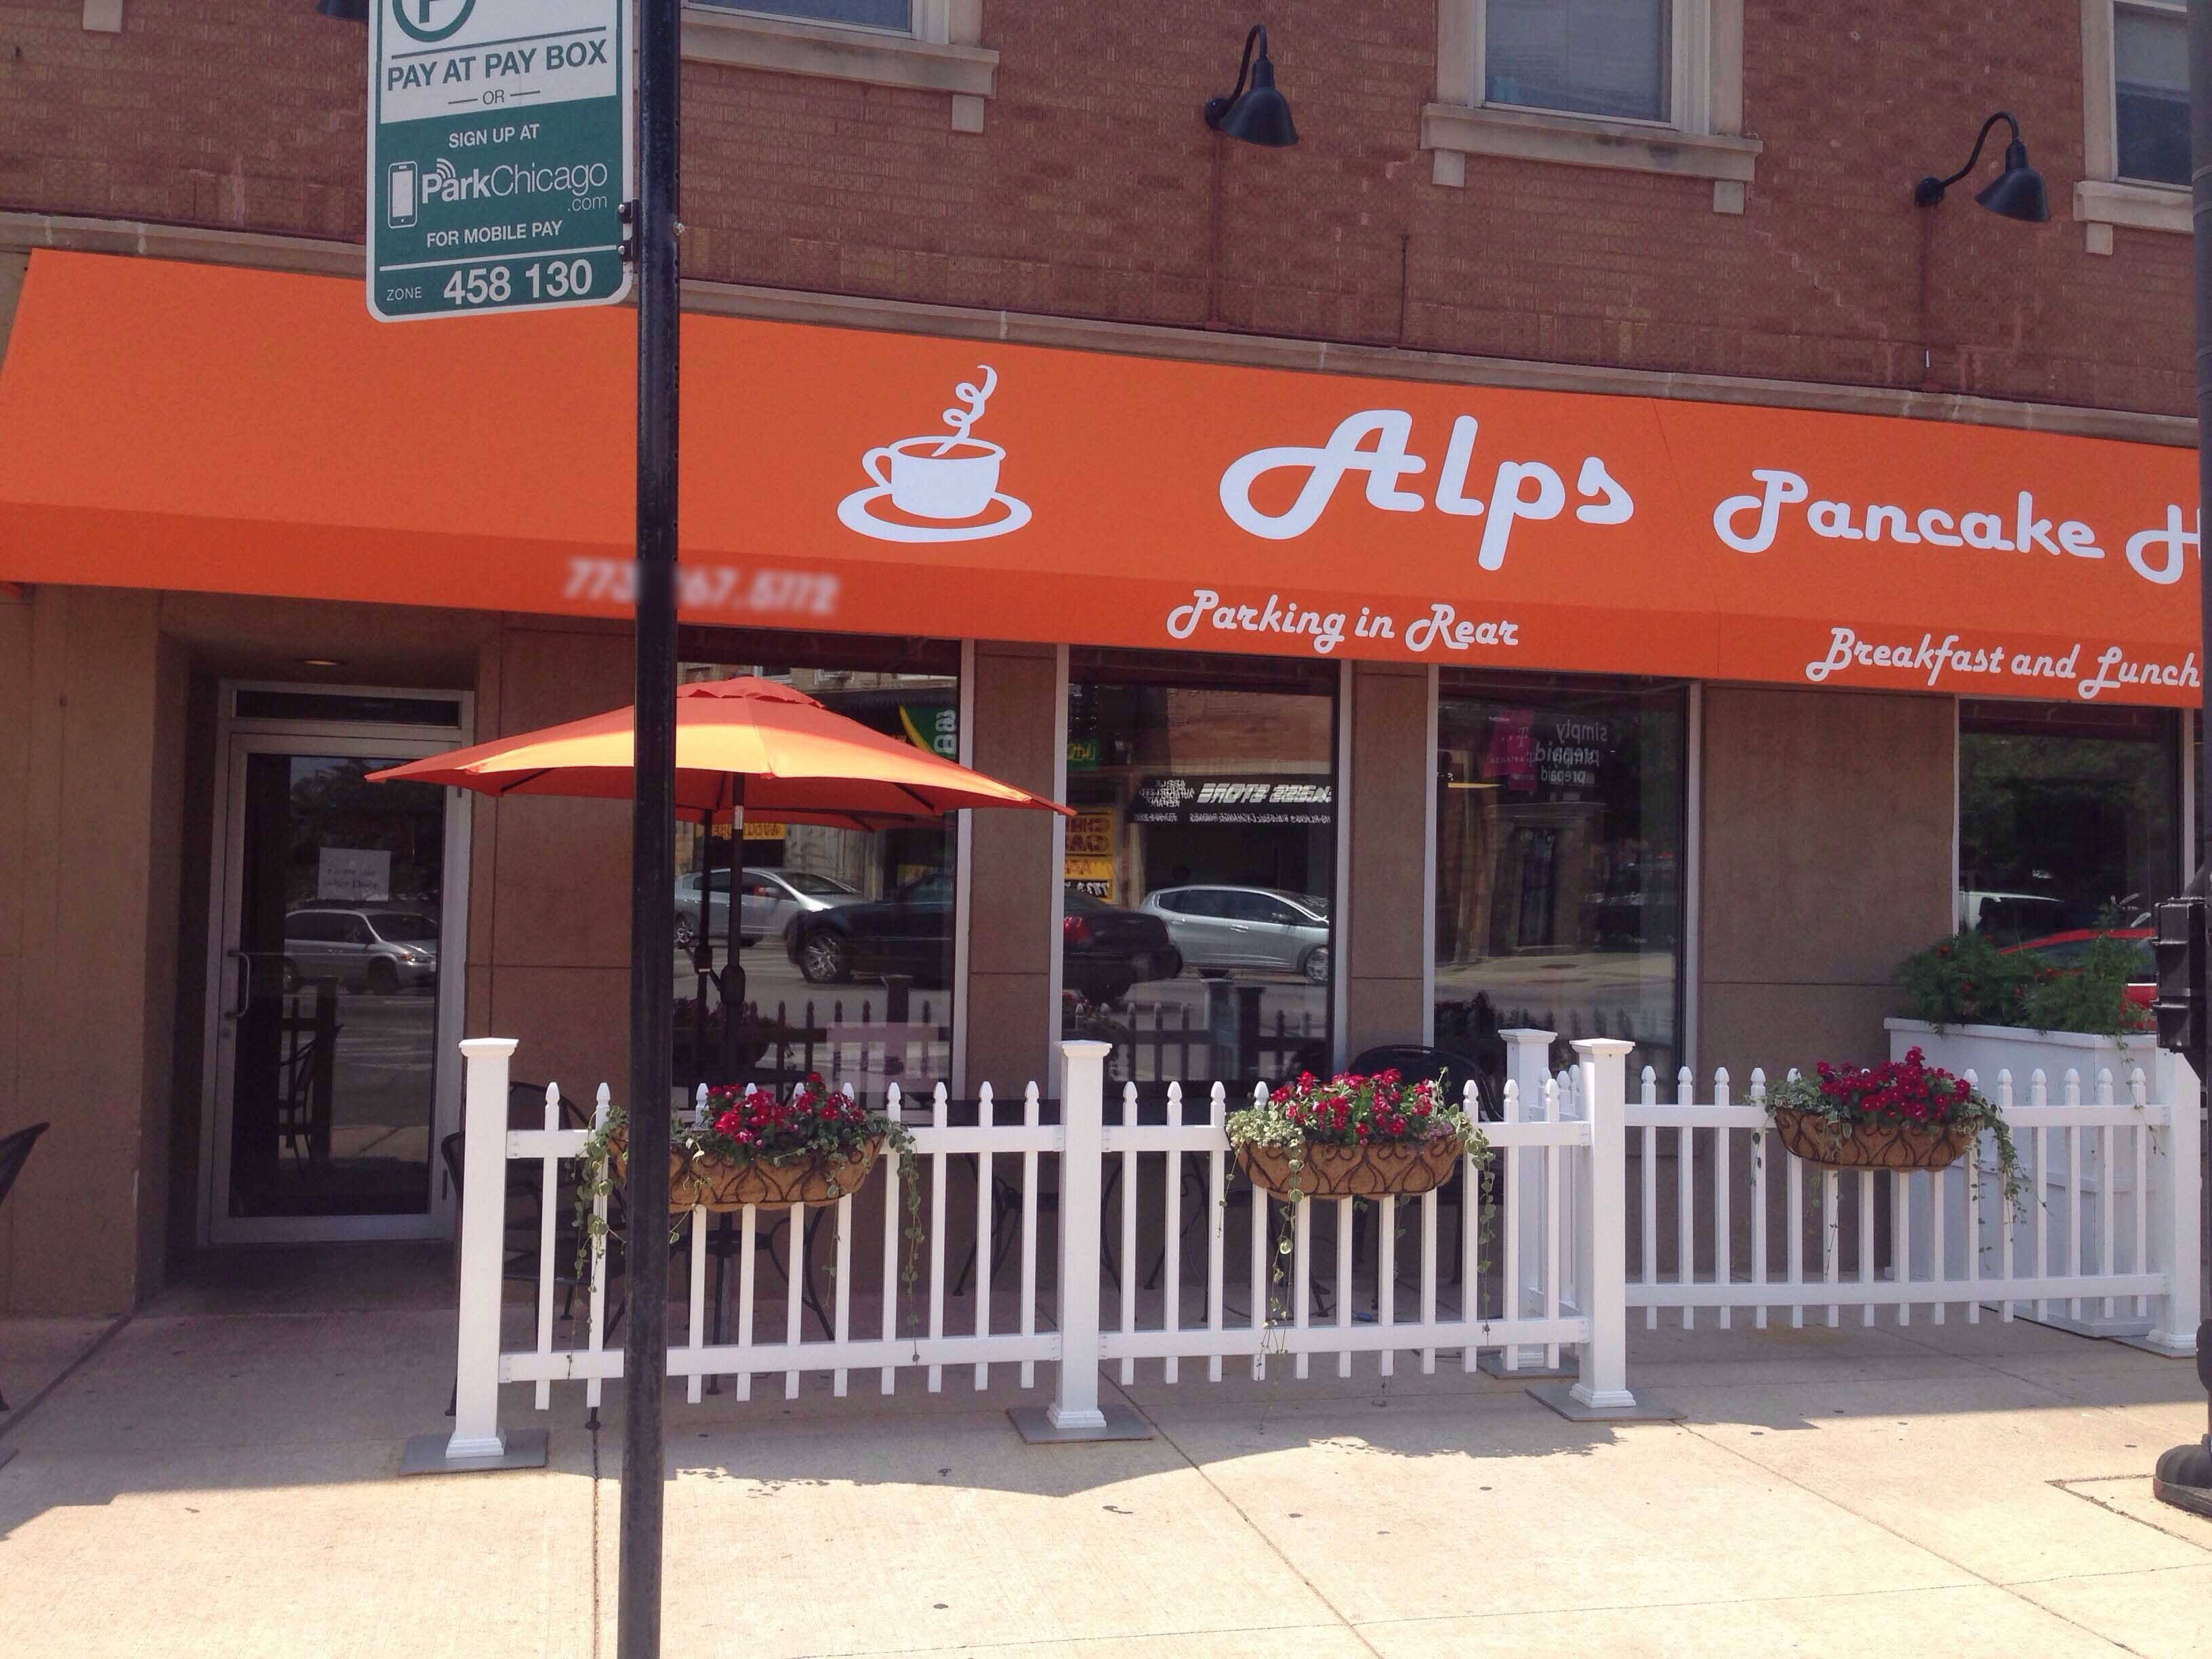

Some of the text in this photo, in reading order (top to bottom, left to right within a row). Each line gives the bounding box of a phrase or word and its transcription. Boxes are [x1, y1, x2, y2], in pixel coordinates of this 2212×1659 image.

[387, 39, 607, 91] PAY AT PAY BOX
[483, 90, 505, 105] OR
[449, 123, 540, 148] SIGN UP AT
[422, 163, 607, 204] ParkChicago
[567, 195, 607, 212] .com
[427, 220, 563, 248] FOR MOBILE PAY
[386, 259, 593, 304] ZONE 458 130
[1220, 409, 1635, 571] Alps
[1713, 469, 2106, 559] Pancake
[1166, 589, 1519, 654] Parking in Rear
[1805, 628, 2201, 699] Breakfast and Lunch
